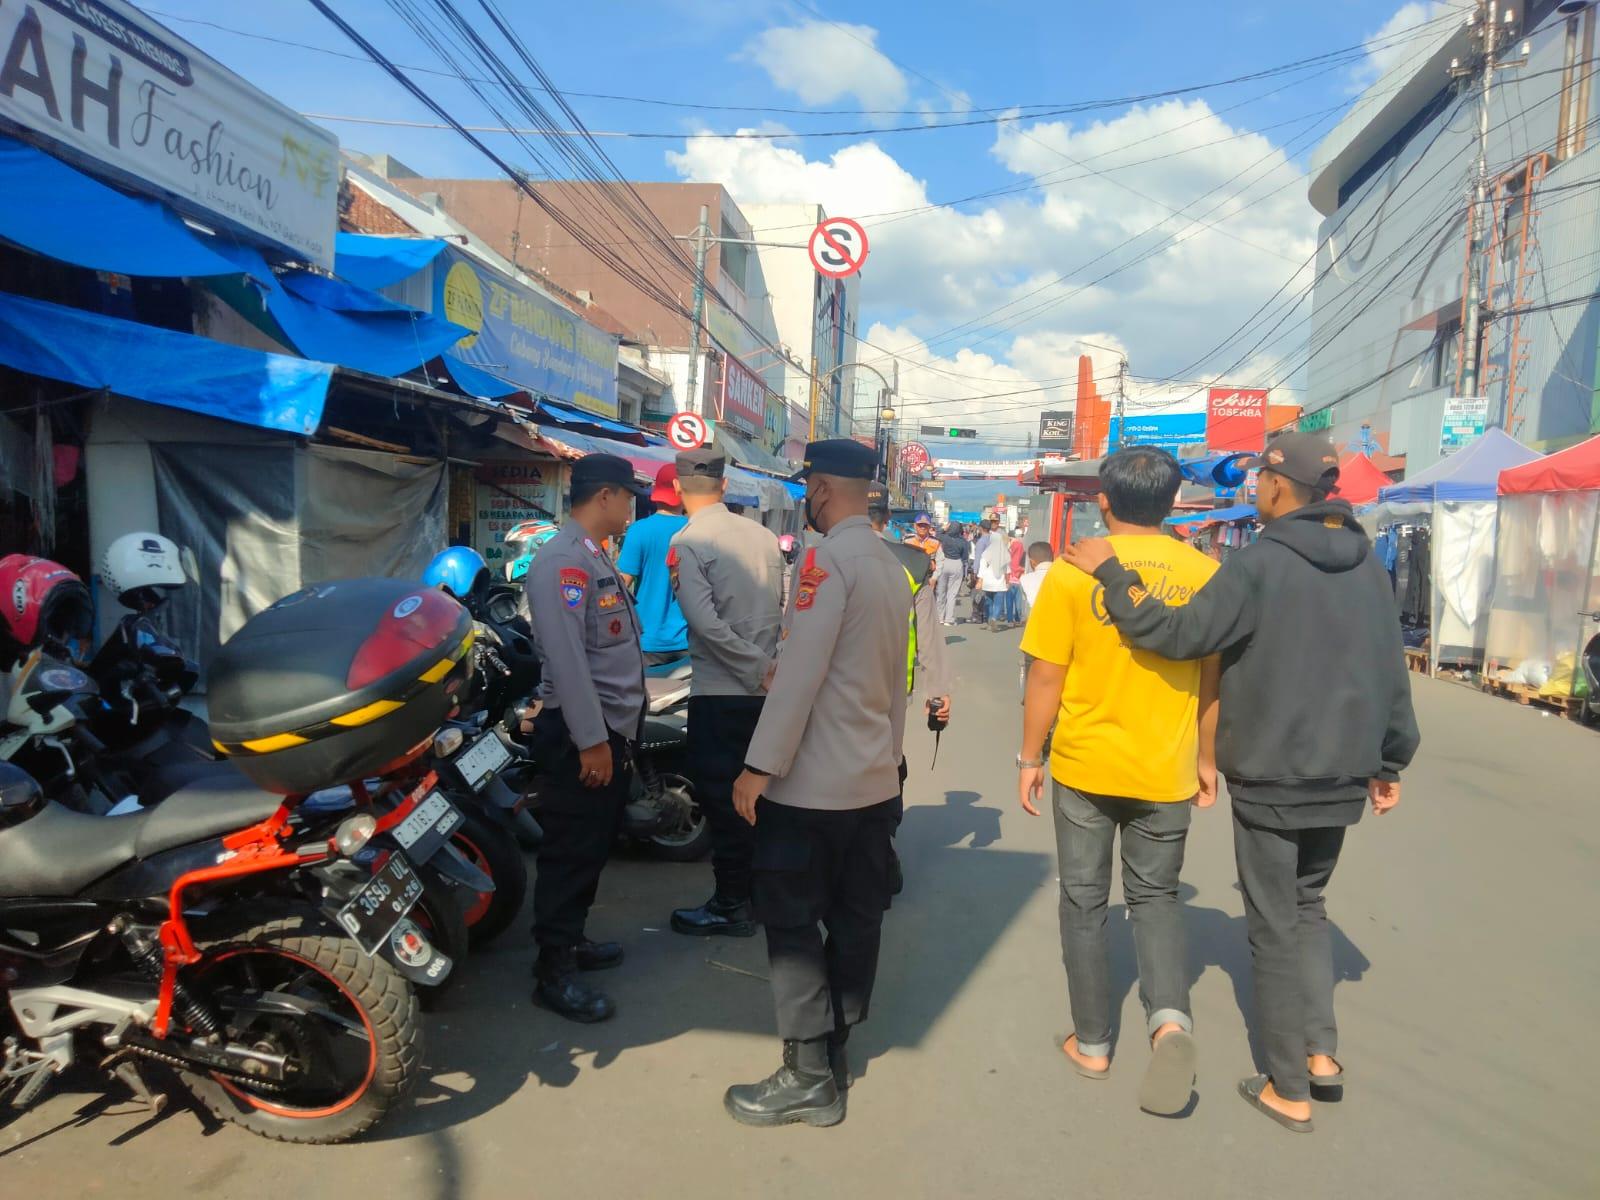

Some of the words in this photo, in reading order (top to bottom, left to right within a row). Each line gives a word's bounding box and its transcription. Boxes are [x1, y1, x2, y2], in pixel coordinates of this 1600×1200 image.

[126, 29, 185, 77] TRENDS
[131, 79, 279, 211] Fashion
[728, 365, 765, 417] SANKEN
[1212, 392, 1262, 407] Asia
[1212, 407, 1262, 418] TOSERBA
[343, 912, 362, 934] D
[359, 878, 392, 917] 3696
[391, 860, 410, 881] UL
